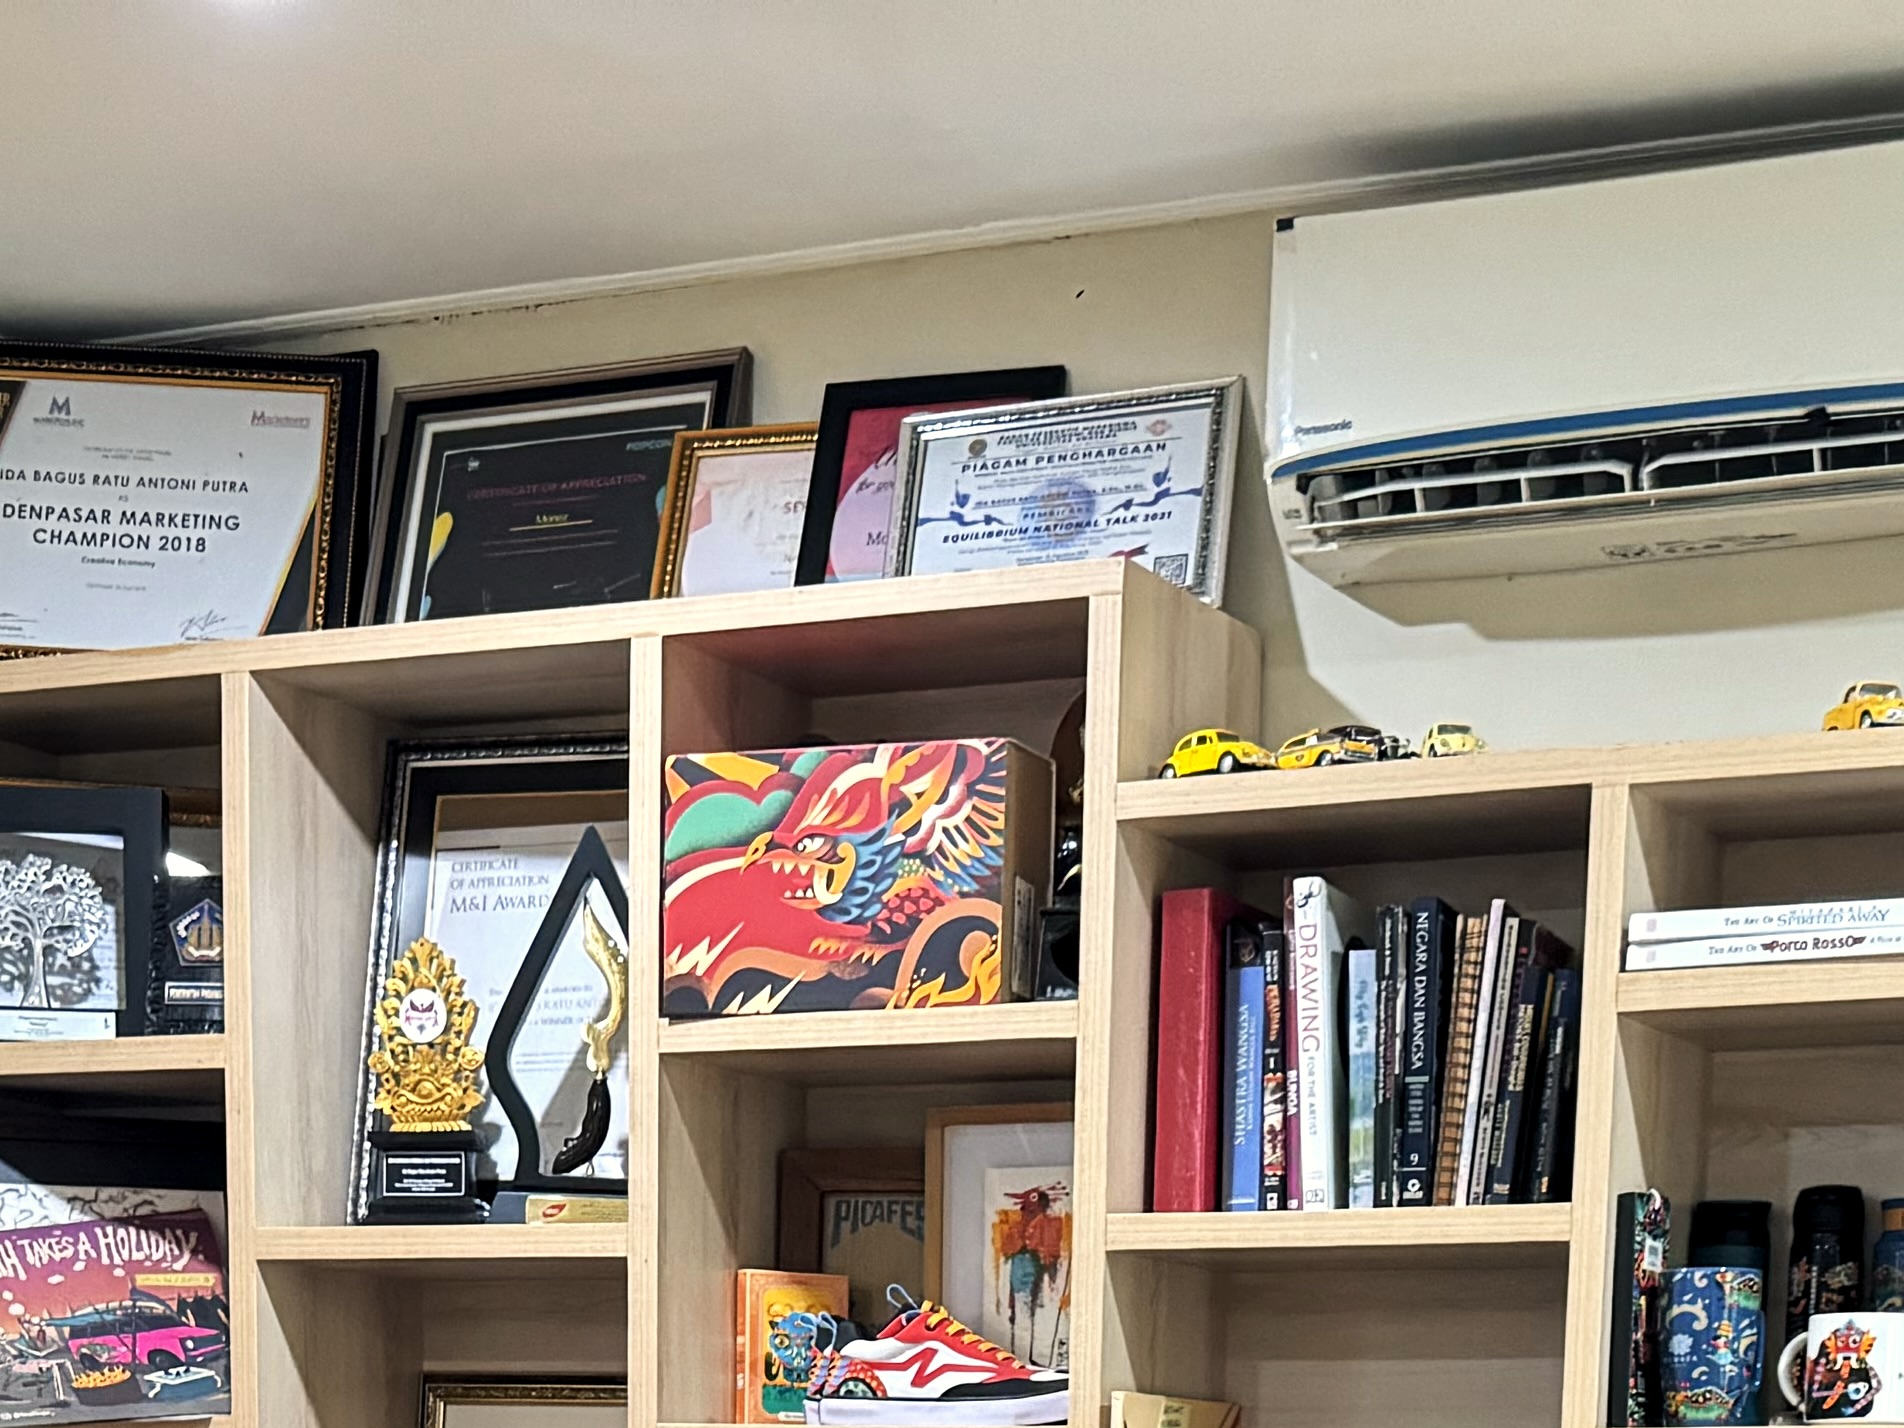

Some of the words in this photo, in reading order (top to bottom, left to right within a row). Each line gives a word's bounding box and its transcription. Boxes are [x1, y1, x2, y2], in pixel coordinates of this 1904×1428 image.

[961, 457, 1027, 474] PIAGAM
[1035, 442, 1167, 465] PENGHARGAAN
[32, 469, 86, 486] BAGUS
[92, 473, 130, 489] RATU
[136, 475, 196, 492] ANTONI
[203, 478, 249, 494] PUTRA
[2, 501, 112, 526] DENPASAR
[119, 509, 241, 532] MARKETING
[1033, 518, 1099, 537] NATIONAL
[1104, 514, 1139, 530] TALK
[32, 528, 150, 551] CHAMPION
[158, 534, 207, 554] 2018
[451, 858, 519, 873] CERTIFICATE
[449, 876, 466, 890] OF
[469, 874, 549, 889] APPRECIATION
[449, 894, 489, 913] M&I
[1848, 908, 1890, 923] AWAY
[1415, 911, 1431, 972] NEGARA
[1298, 923, 1321, 1054] DRAWING
[1414, 976, 1428, 1006] DAN
[1235, 1003, 1250, 1069] WANGSA
[1410, 1008, 1425, 1071] BANGSA
[20, 1235, 75, 1268] TAKES
[73, 1230, 98, 1263] A
[96, 1224, 198, 1272] HOLIDAY
